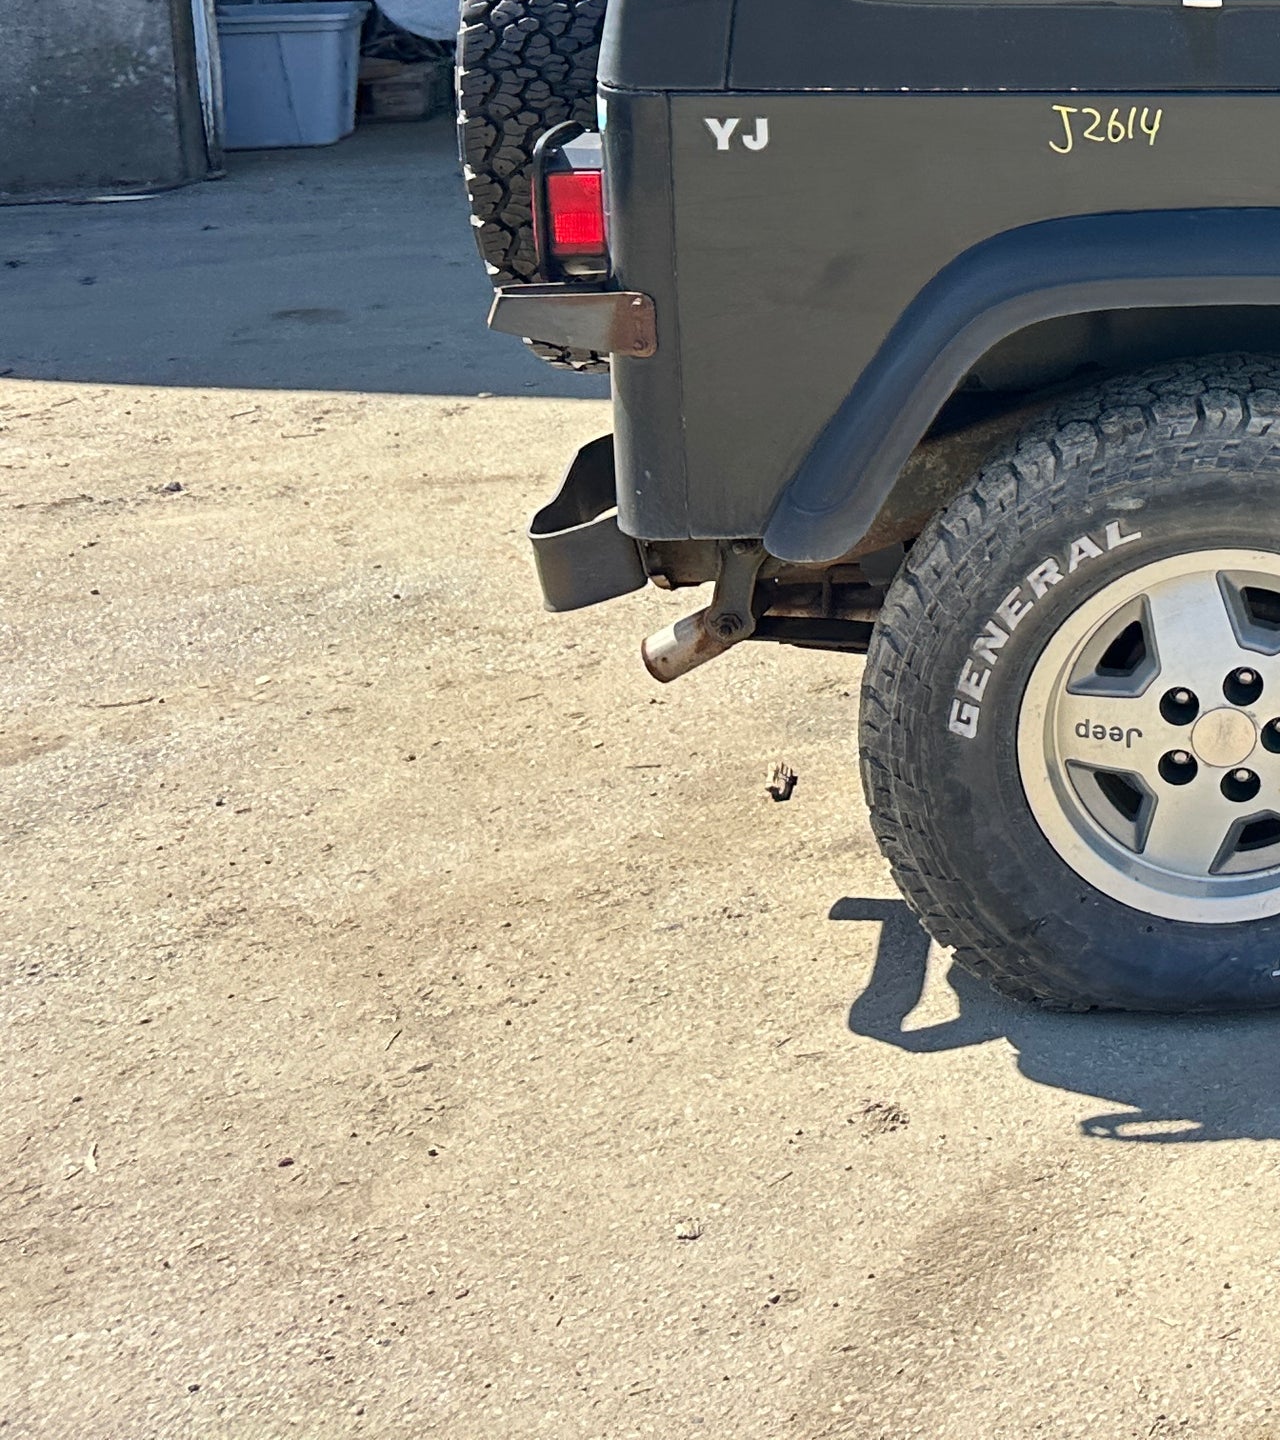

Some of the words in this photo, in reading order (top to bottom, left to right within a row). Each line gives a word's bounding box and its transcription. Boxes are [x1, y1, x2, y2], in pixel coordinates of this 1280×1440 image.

[705, 117, 770, 151] YJ
[1049, 104, 1163, 154] J2614
[947, 519, 1142, 739] GENERAL
[1075, 718, 1143, 748] Jeep
